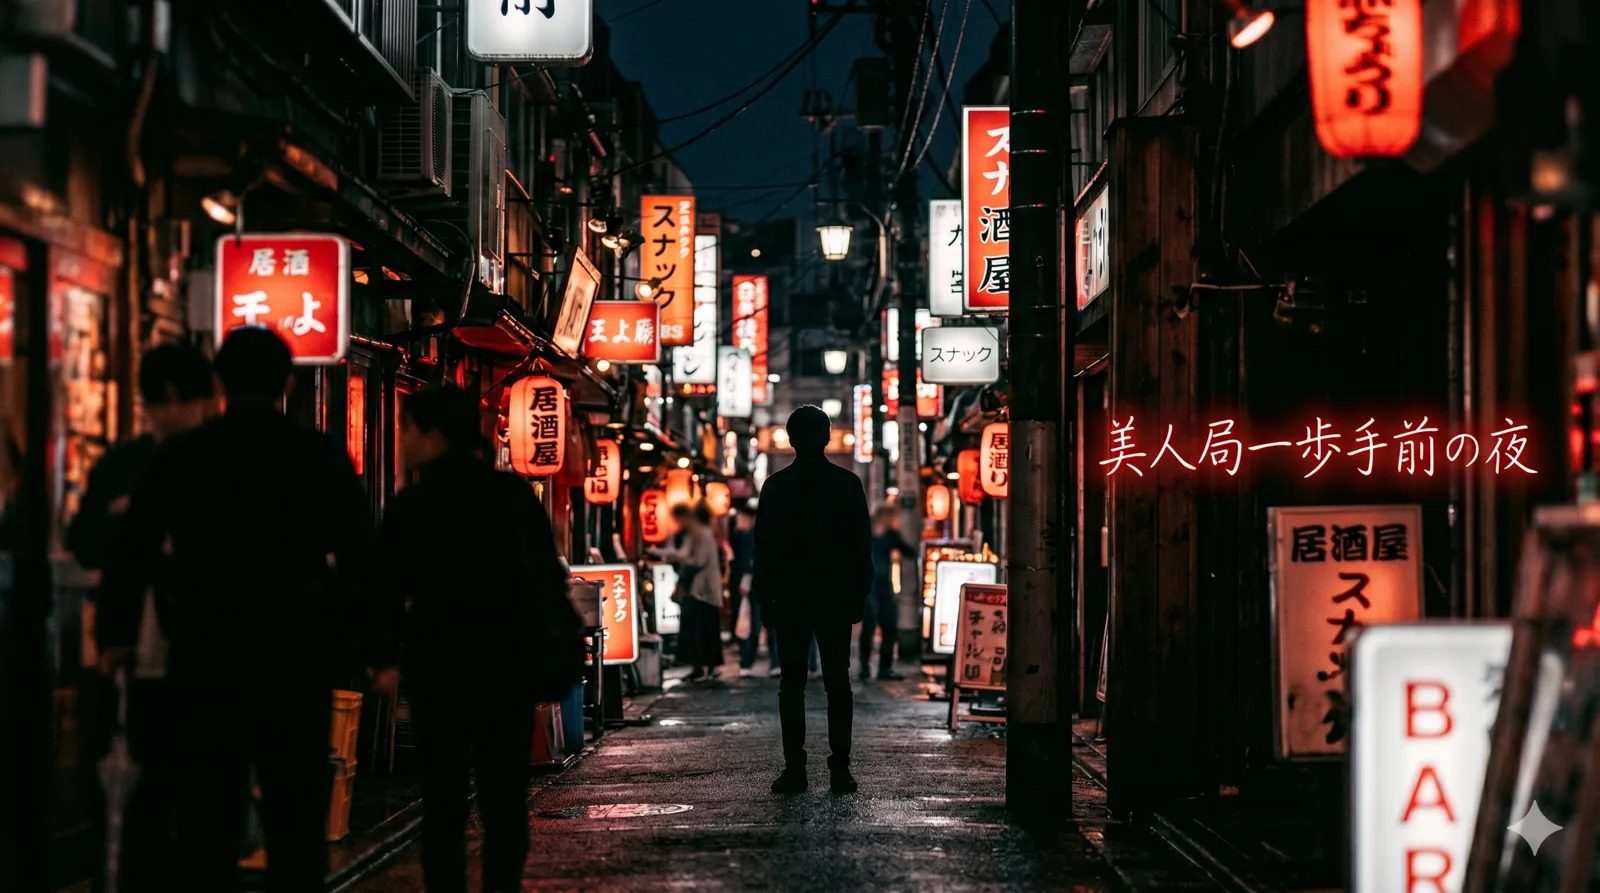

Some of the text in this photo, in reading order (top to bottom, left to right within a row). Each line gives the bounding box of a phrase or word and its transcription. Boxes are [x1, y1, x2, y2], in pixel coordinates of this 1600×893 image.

[248, 247, 310, 277] 居酒
[653, 205, 676, 309] スナック
[930, 347, 992, 362] スナック
[529, 386, 559, 466] 居酒屋
[1291, 524, 1409, 563] 居酒屋
[613, 574, 627, 623] スナック
[1401, 680, 1458, 893] BAR
